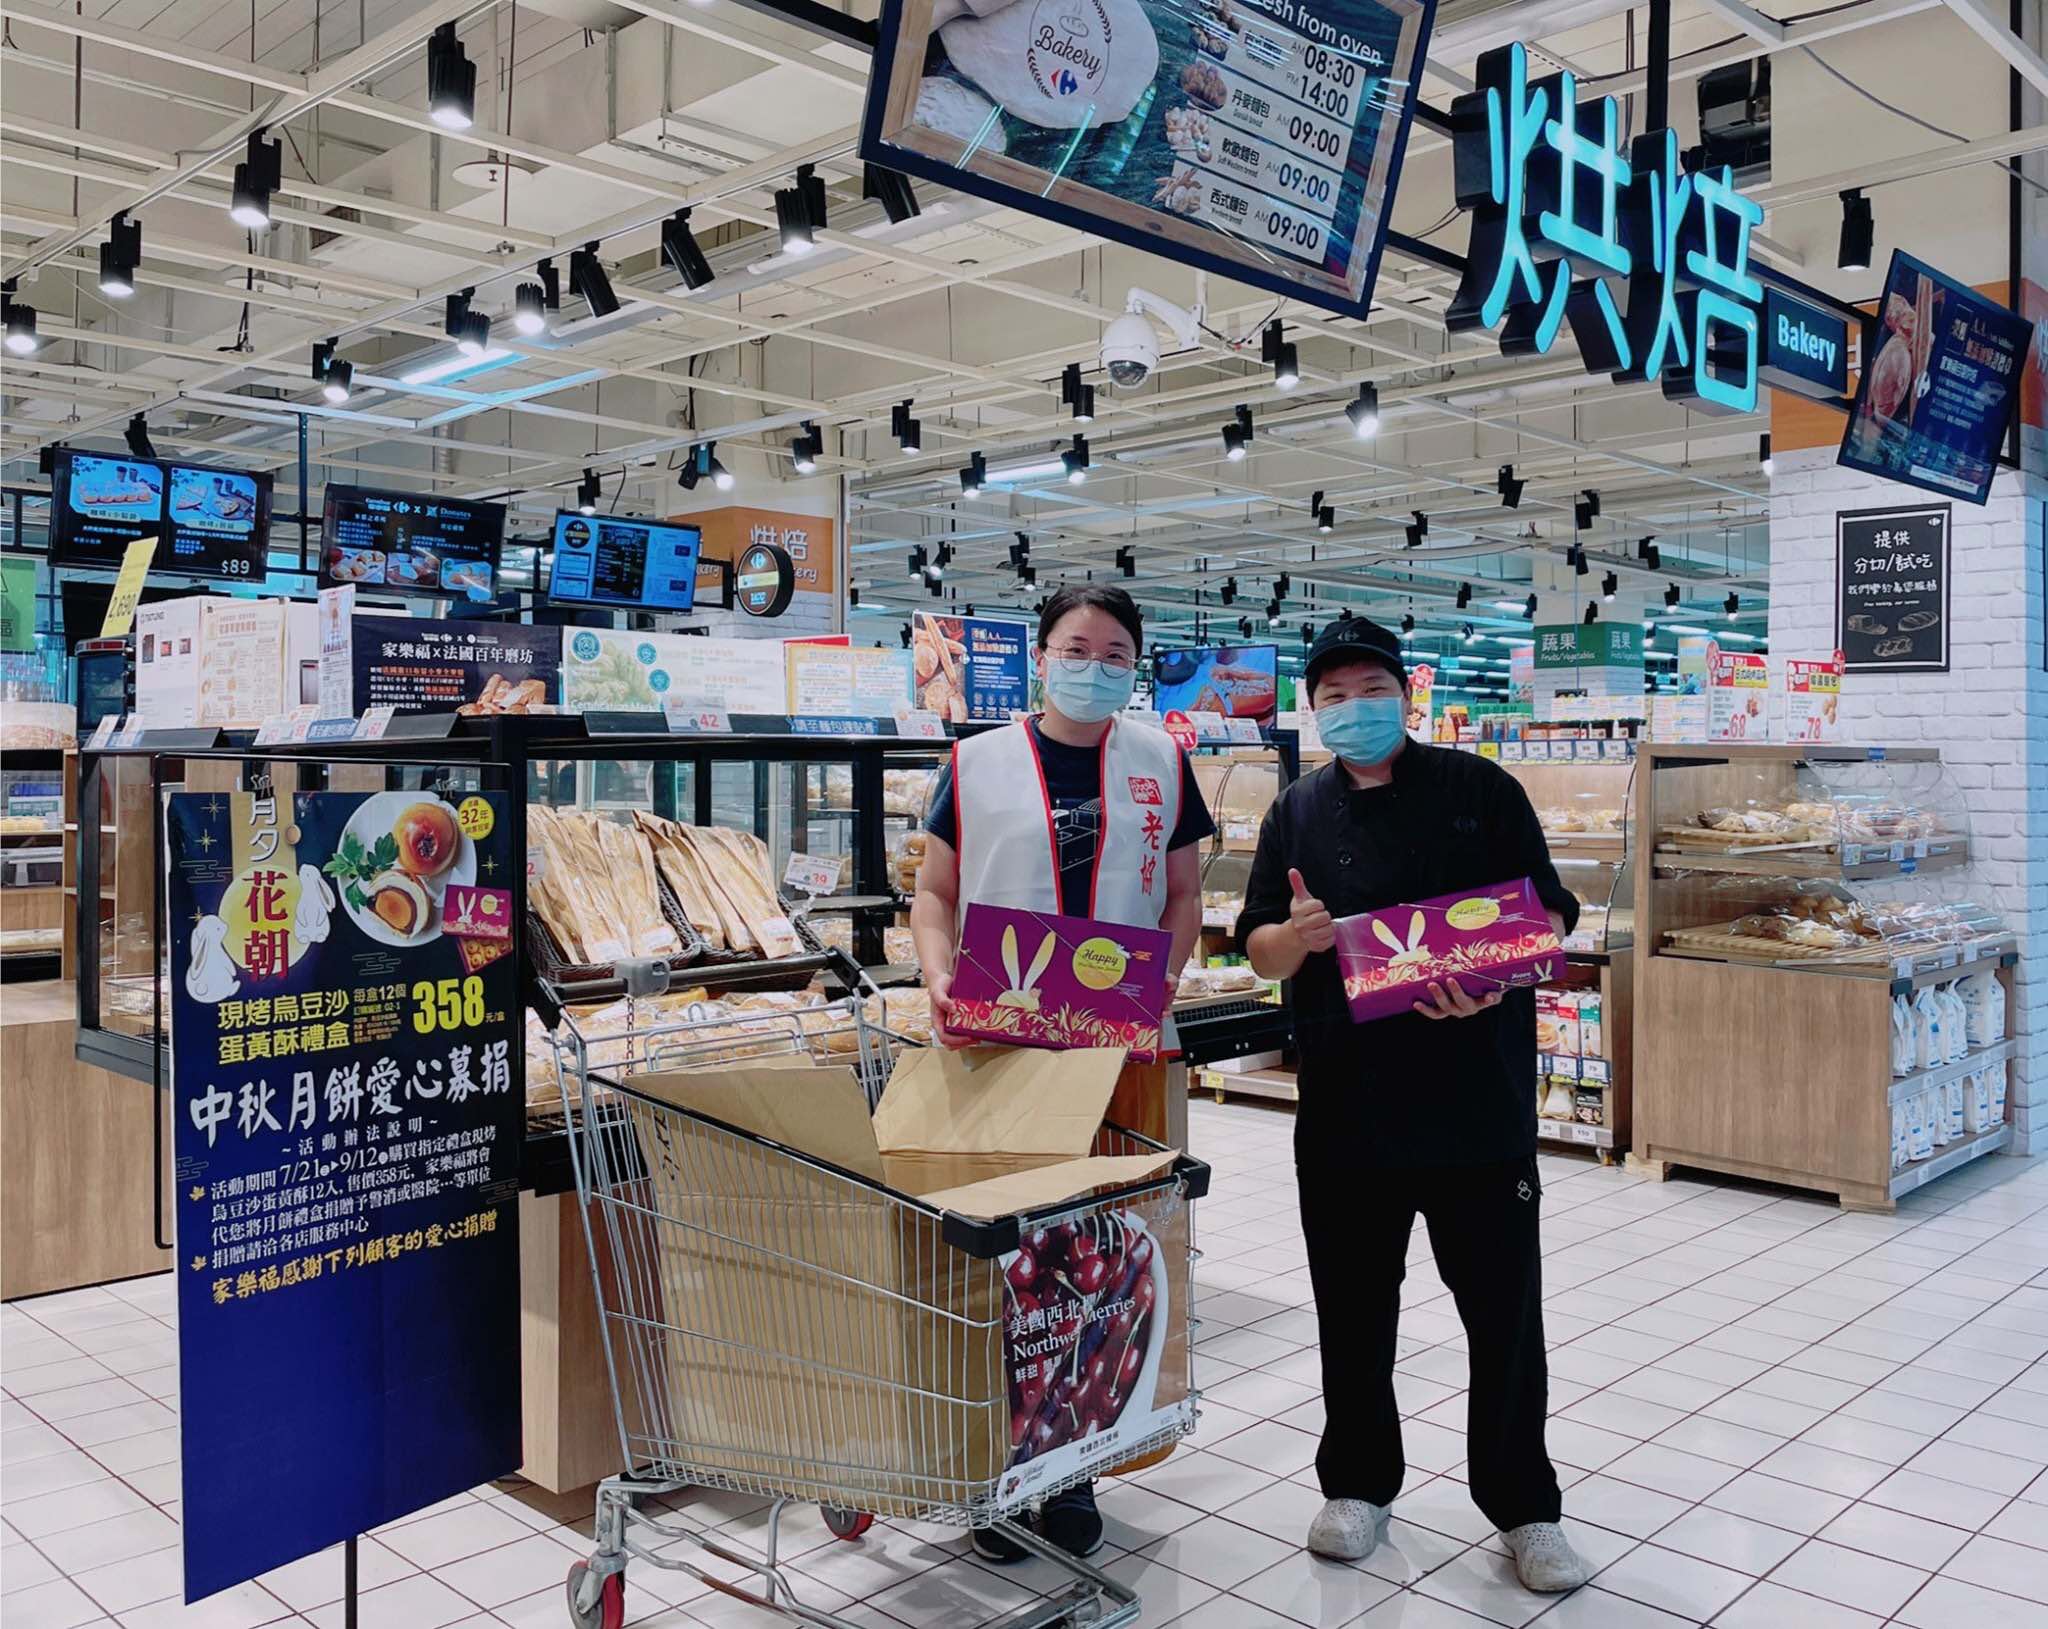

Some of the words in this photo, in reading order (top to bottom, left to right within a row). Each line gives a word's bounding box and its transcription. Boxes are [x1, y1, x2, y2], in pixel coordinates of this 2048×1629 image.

[1035, 25, 1101, 79] Bakery
[1297, 11, 1336, 45] from
[1339, 33, 1381, 66] oven
[1304, 45, 1355, 88] 08:30
[1299, 75, 1349, 118] 14:00
[1289, 116, 1340, 157] 09:00
[1210, 188, 1248, 216] 西式麵包
[1279, 163, 1330, 203] 09:00
[1268, 212, 1319, 250] 09:00
[1481, 41, 1765, 414] 烘焙
[1777, 314, 1837, 373] Bakery
[1874, 530, 1911, 549] 提供
[221, 560, 249, 576] $89
[1854, 553, 1933, 574] 分切/試吃
[1541, 632, 1576, 652] 蔬果
[700, 714, 719, 728] 42
[1730, 714, 1746, 738] 68
[1808, 717, 1821, 739] 78
[243, 871, 290, 983] 花朝
[1082, 948, 1119, 967] Happy
[218, 989, 349, 1031] 現烤烏豆沙
[413, 976, 484, 1034] 358
[219, 1022, 349, 1064] 蛋黃酥禮盒
[190, 1040, 511, 1148] 中秋月餅愛心募捐
[212, 1209, 497, 1304] 家樂福感謝下列顧客的愛心捐贈
[1015, 1363, 1038, 1384] 鮮甜
